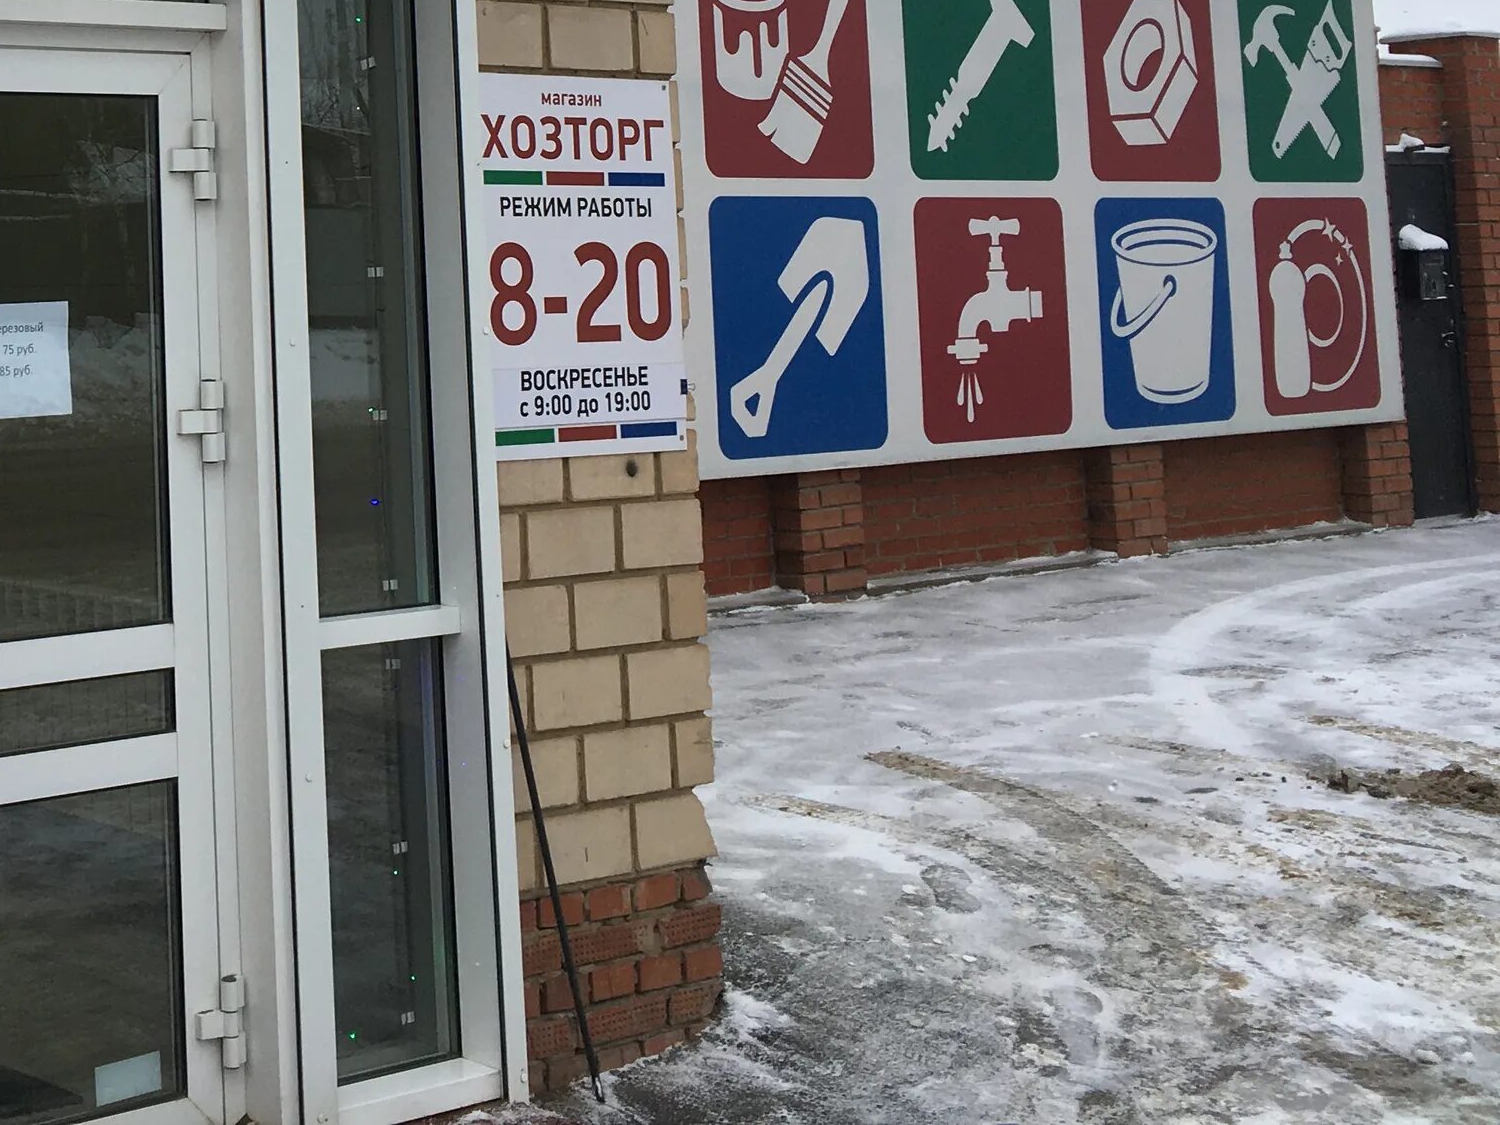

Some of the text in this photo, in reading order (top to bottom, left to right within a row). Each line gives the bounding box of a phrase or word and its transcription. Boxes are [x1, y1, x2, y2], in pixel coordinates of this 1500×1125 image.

[540, 91, 602, 107] магазин
[480, 114, 665, 162] ХОЗТОРГ
[500, 196, 652, 218] РЕЖИМ РАБОТЫ
[489, 241, 672, 346] 8-20
[3, 345, 14, 355] 75
[16, 343, 37, 358] руб.
[0, 366, 11, 376] 85
[13, 364, 33, 378] руб.
[520, 365, 649, 392] ВОСКРЕСЕНЬЕ
[519, 390, 651, 419] с 9:00 до 19:00
